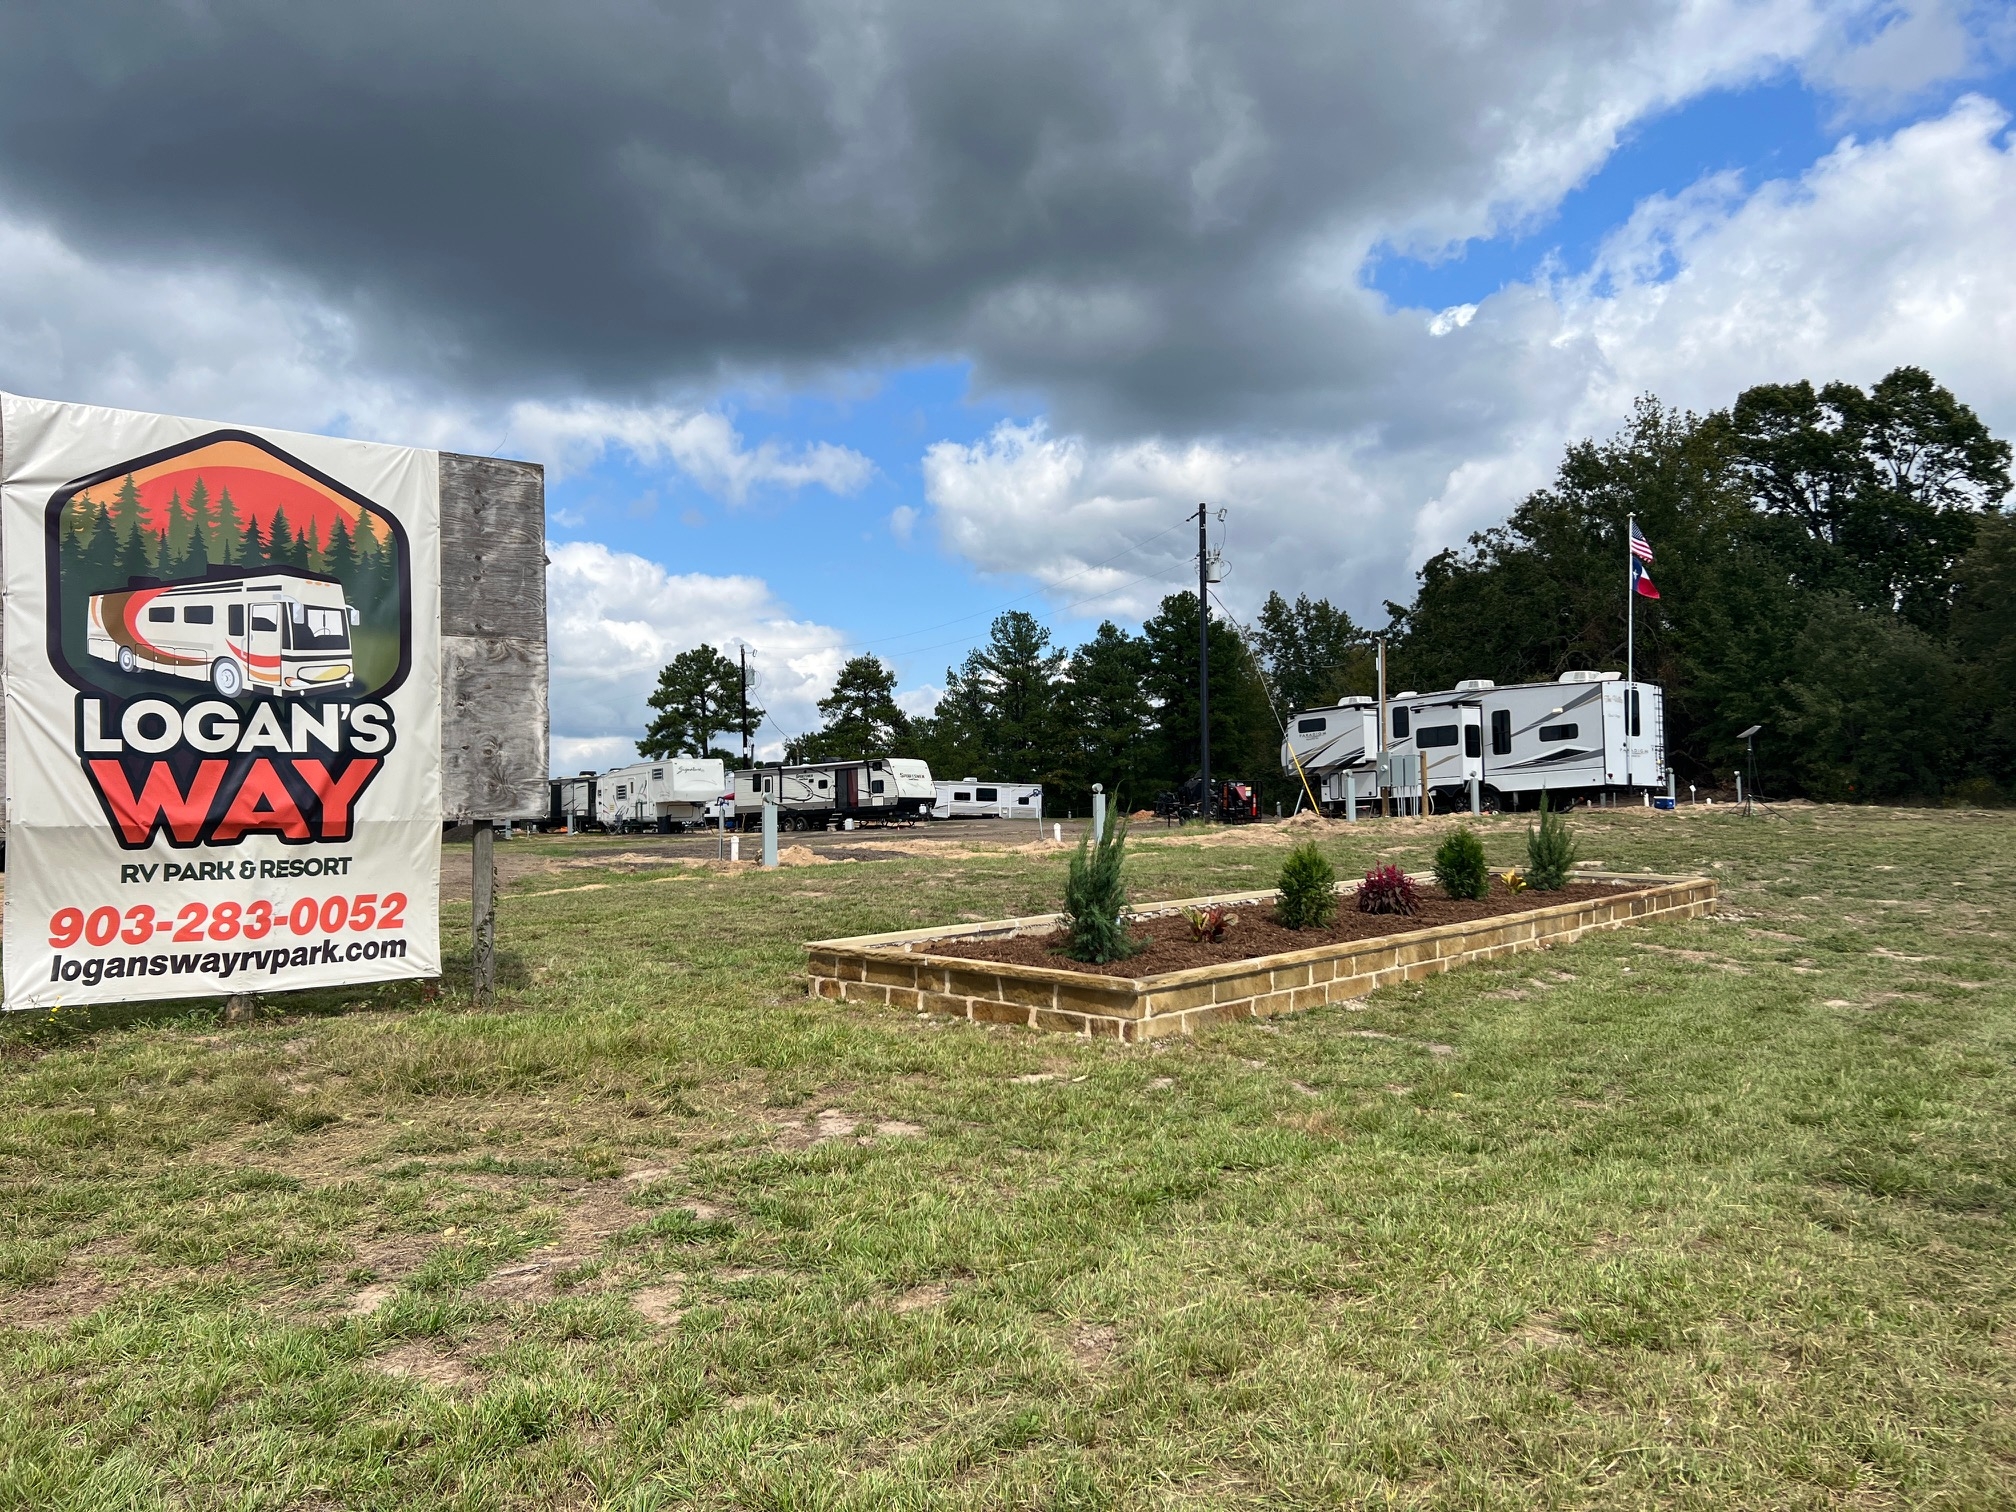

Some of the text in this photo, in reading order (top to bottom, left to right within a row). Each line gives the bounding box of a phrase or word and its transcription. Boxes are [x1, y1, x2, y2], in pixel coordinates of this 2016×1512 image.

[83, 699, 391, 753] LOGAN'S
[89, 758, 379, 844] WAY
[120, 857, 353, 884] RV PARK & RESORT
[48, 893, 407, 949] 903-283-0052
[50, 939, 407, 987] loganswayrvpark.com
